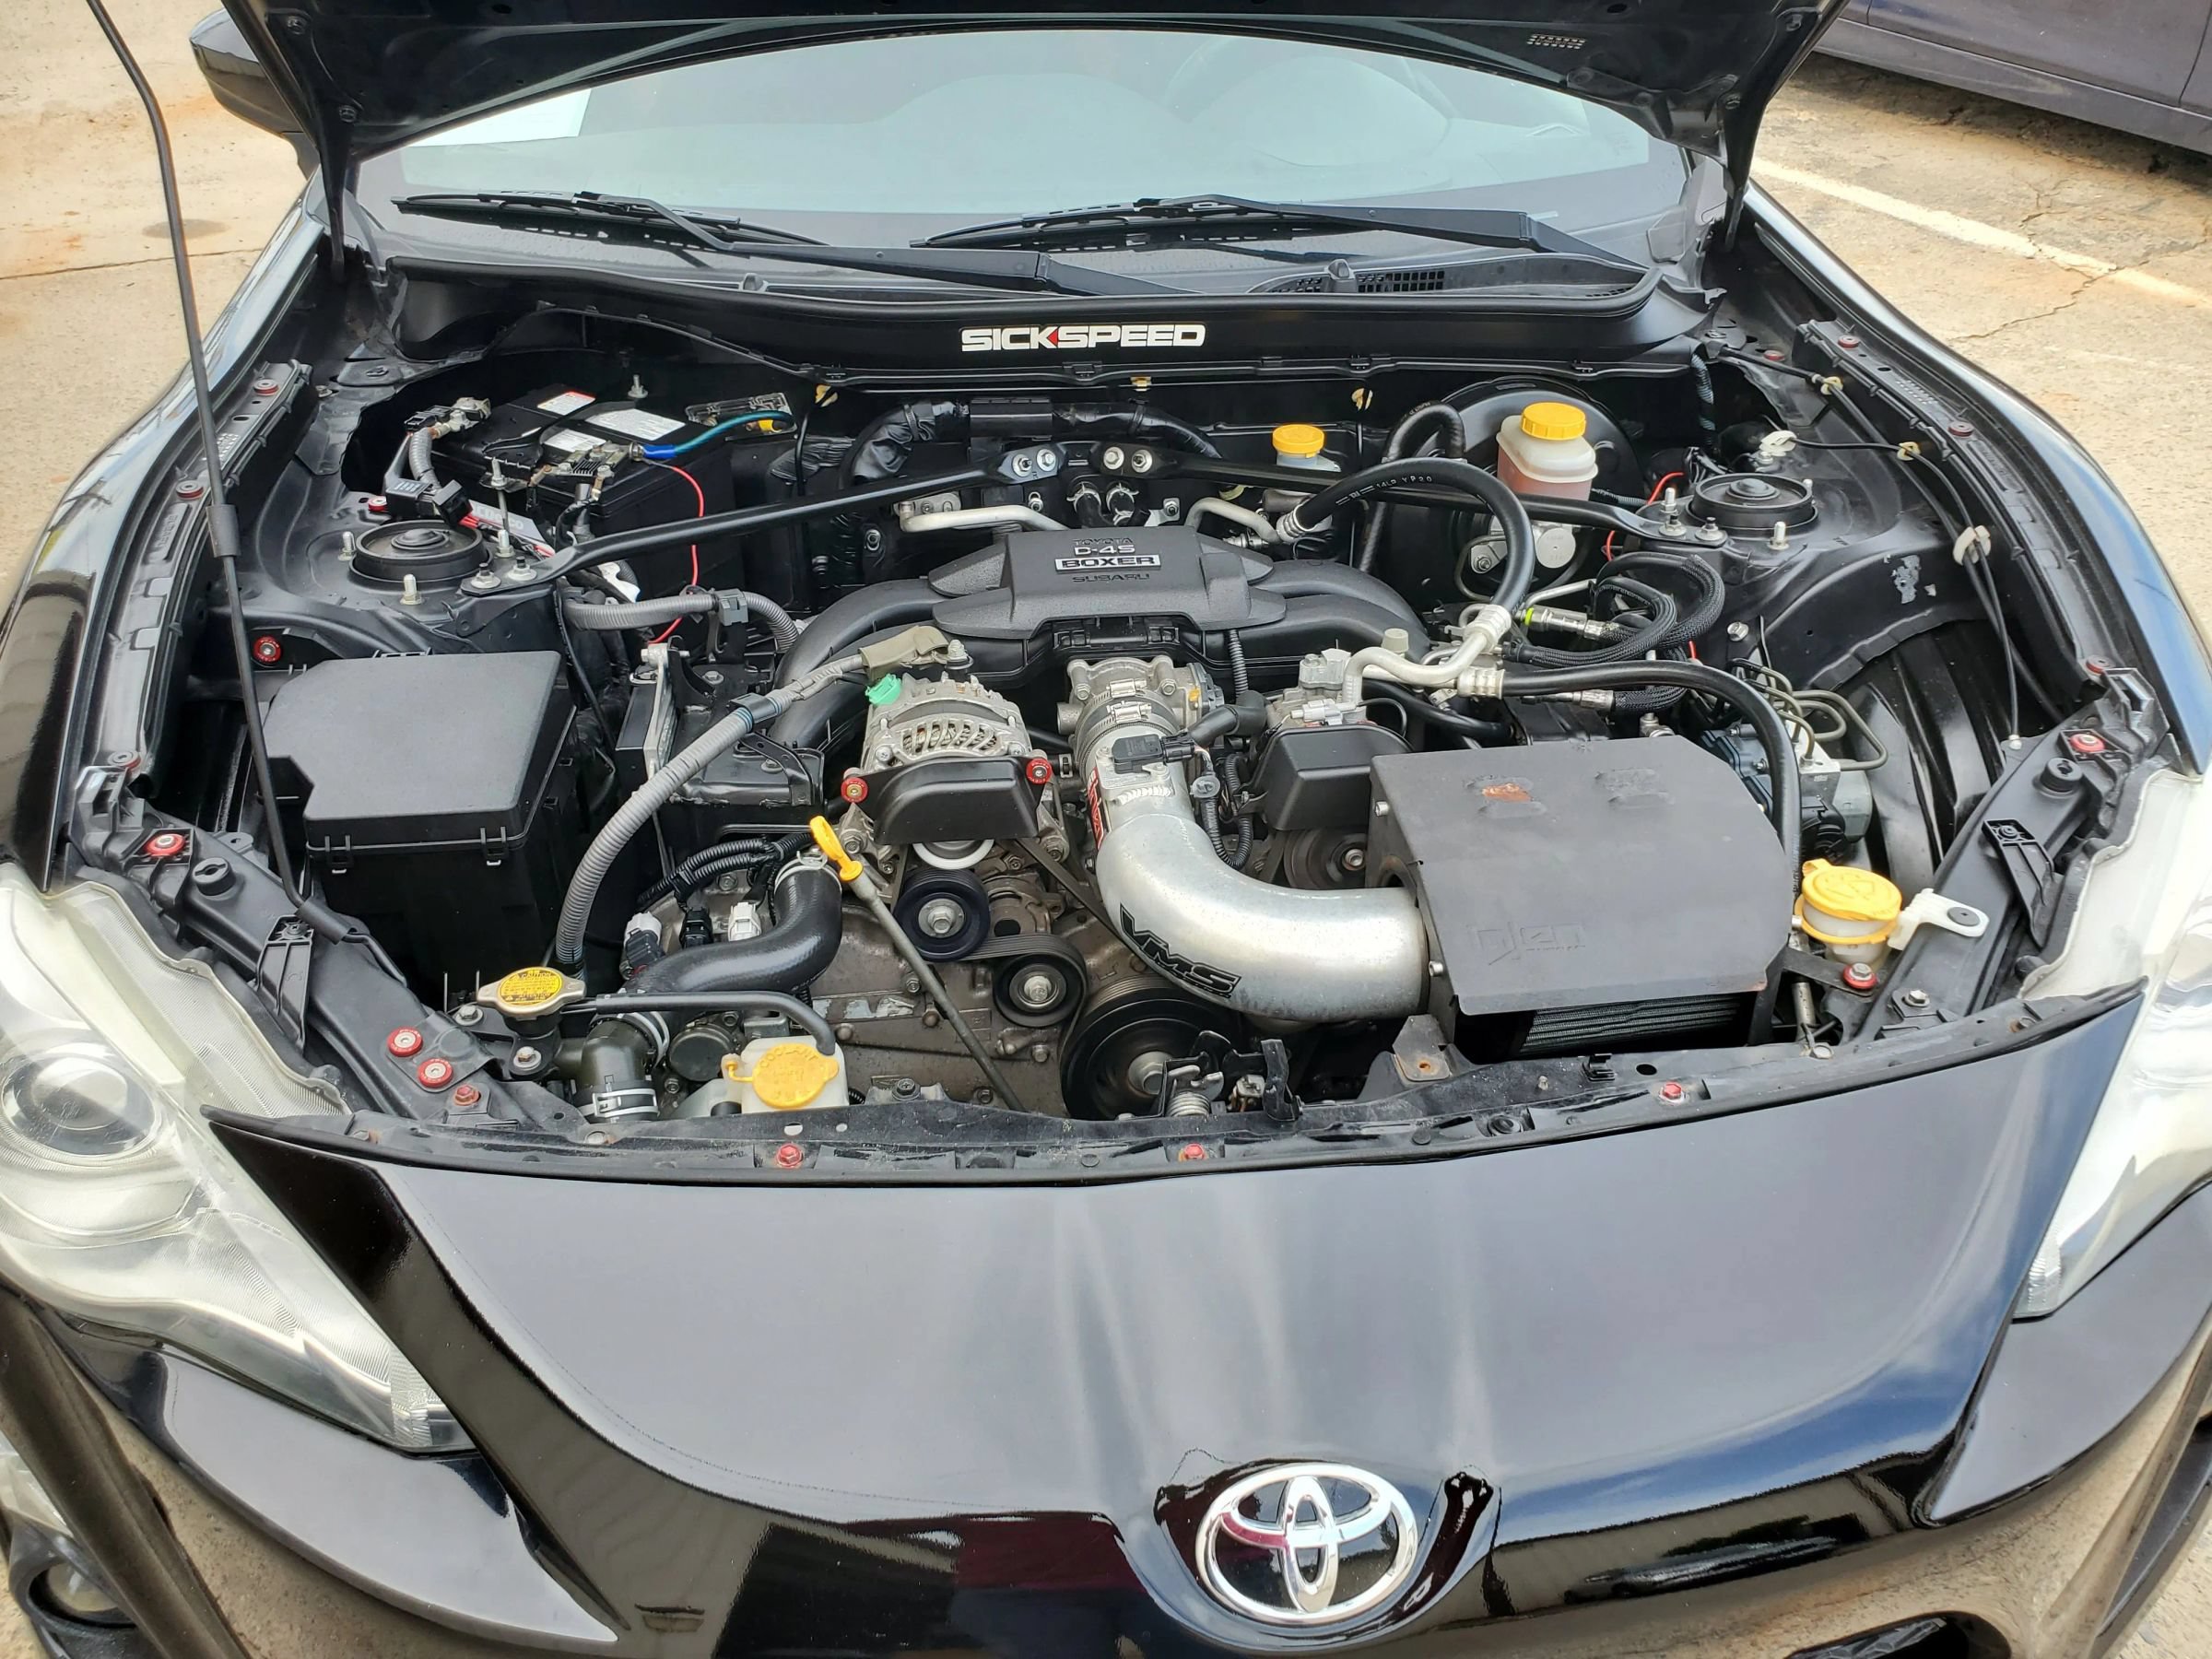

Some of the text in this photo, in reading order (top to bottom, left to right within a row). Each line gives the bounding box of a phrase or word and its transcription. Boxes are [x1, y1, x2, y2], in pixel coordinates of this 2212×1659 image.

[961, 324, 1206, 352] SICKSPEED
[1071, 537, 1134, 546] TOYOTA
[1073, 544, 1136, 556] D-4S
[1062, 556, 1156, 569] BOXER
[1071, 572, 1151, 582] SUBARU
[1119, 901, 1242, 995] VMS
